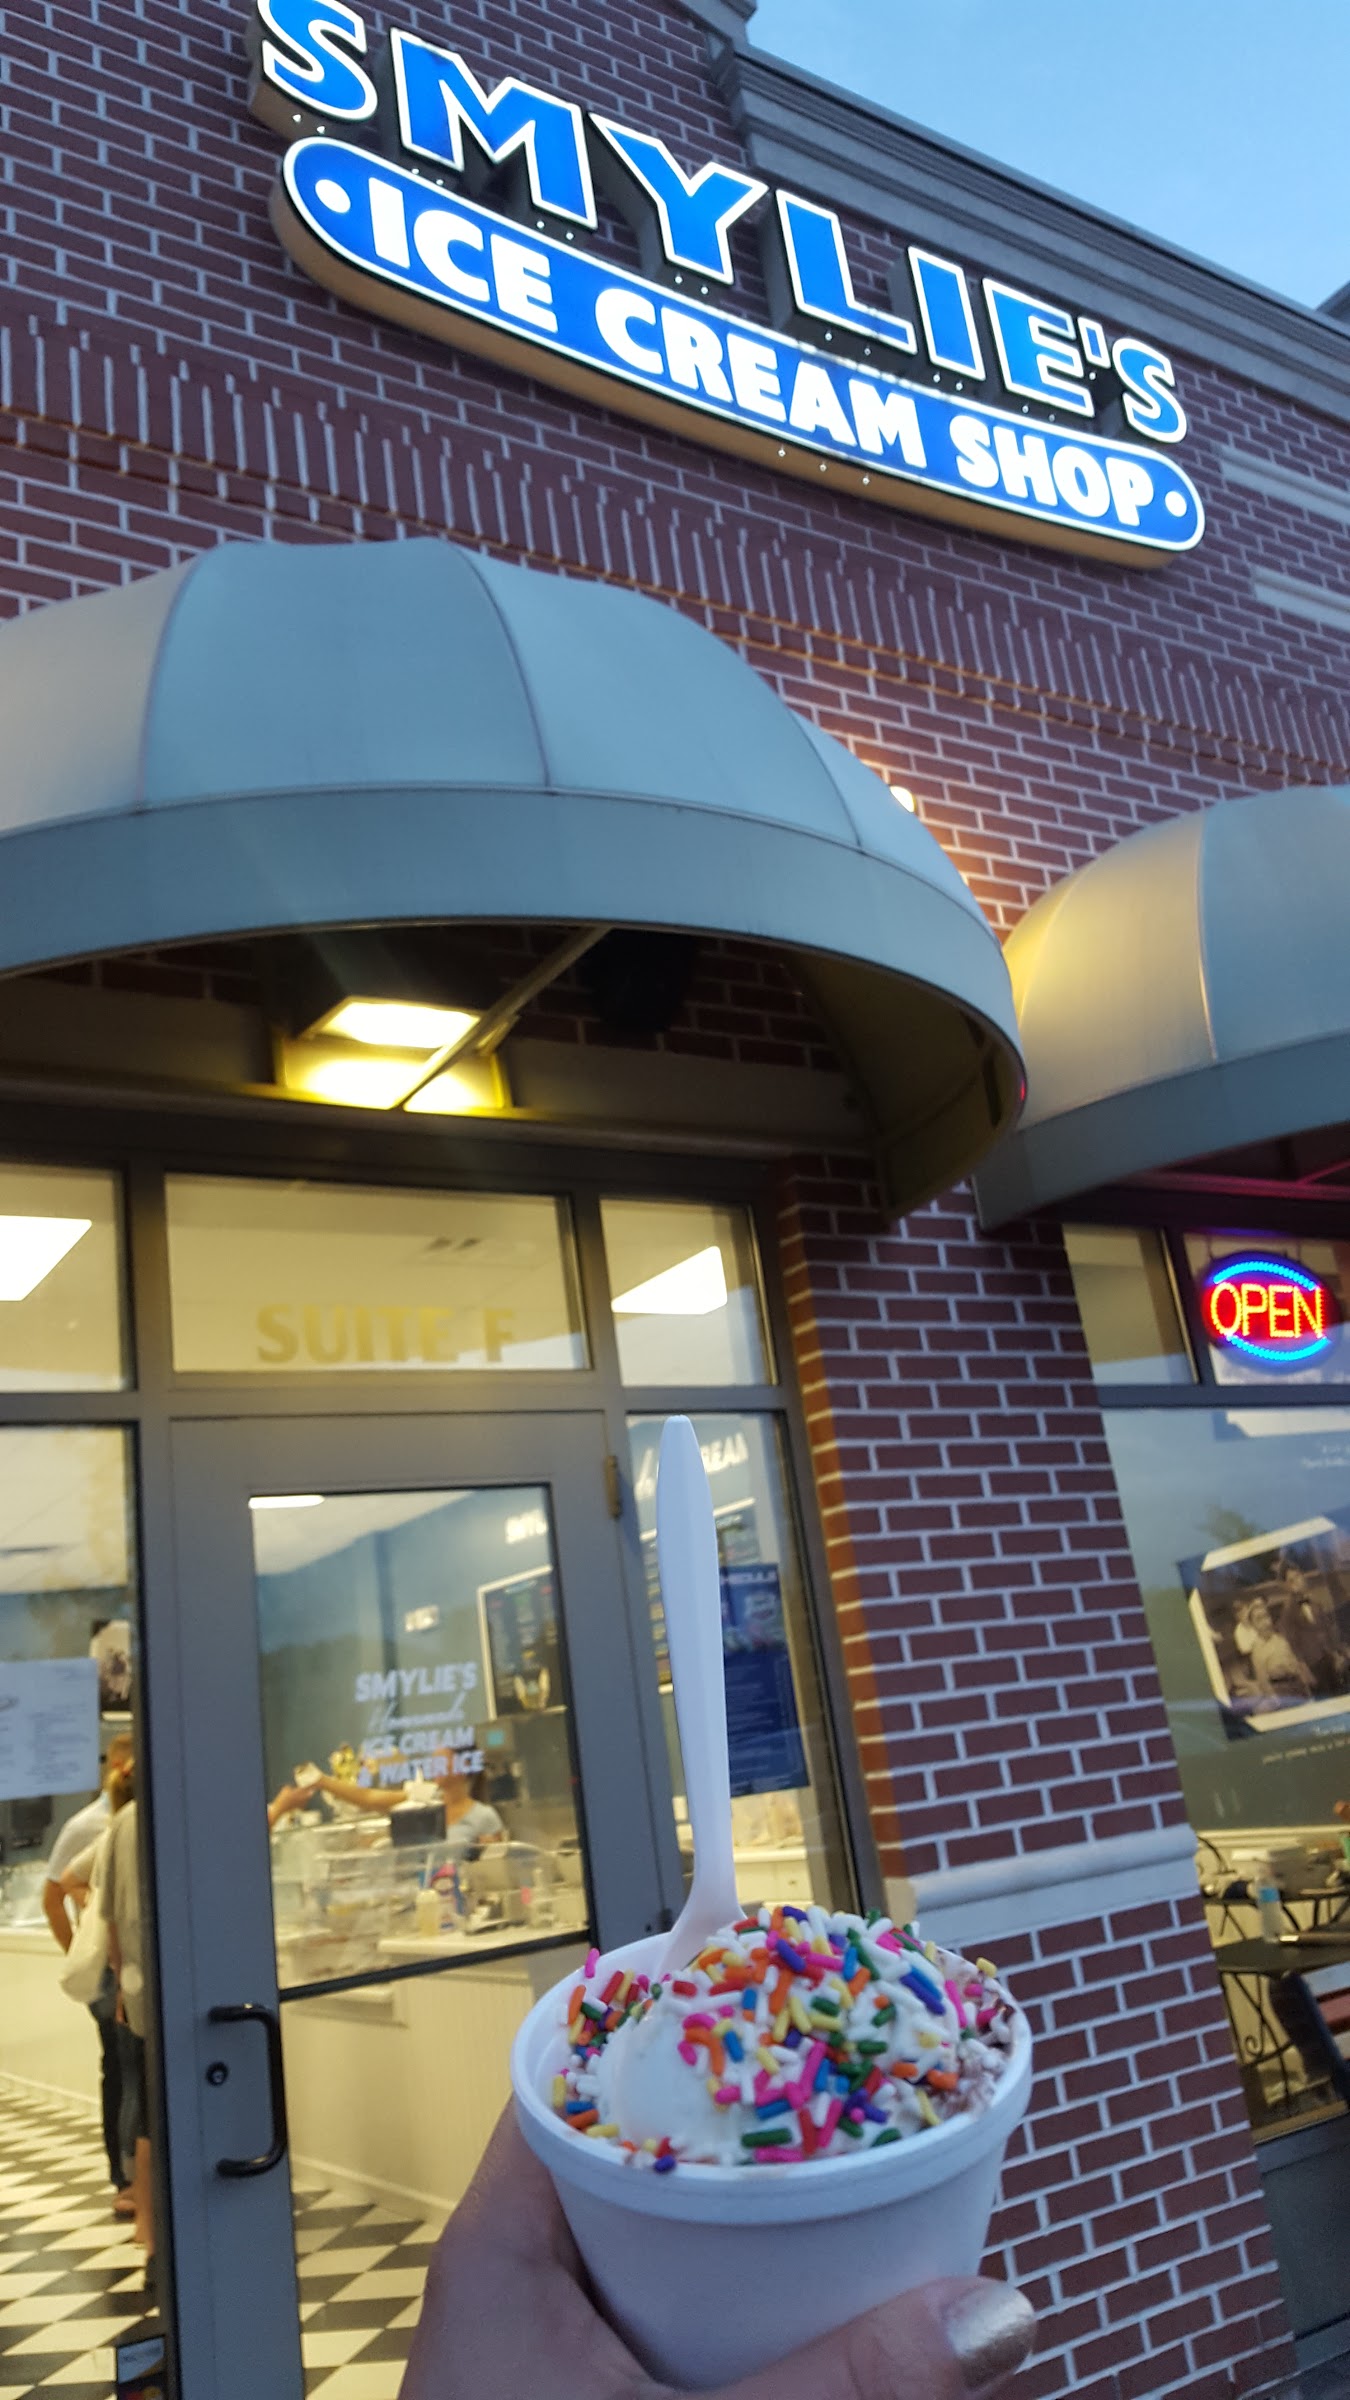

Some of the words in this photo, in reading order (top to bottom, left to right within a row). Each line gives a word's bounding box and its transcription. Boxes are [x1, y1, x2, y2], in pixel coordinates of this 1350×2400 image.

[257, 0, 1188, 444] SMYLIE'S
[368, 177, 559, 334] ICE
[594, 288, 928, 469] CREAM
[949, 414, 1155, 527] SHOP
[256, 1303, 461, 1364] SUITE
[483, 1306, 517, 1363] F
[1210, 1281, 1325, 1340] OPEN
[354, 1661, 477, 1703] SMYLIE'S
[452, 1749, 485, 1775] ICE
